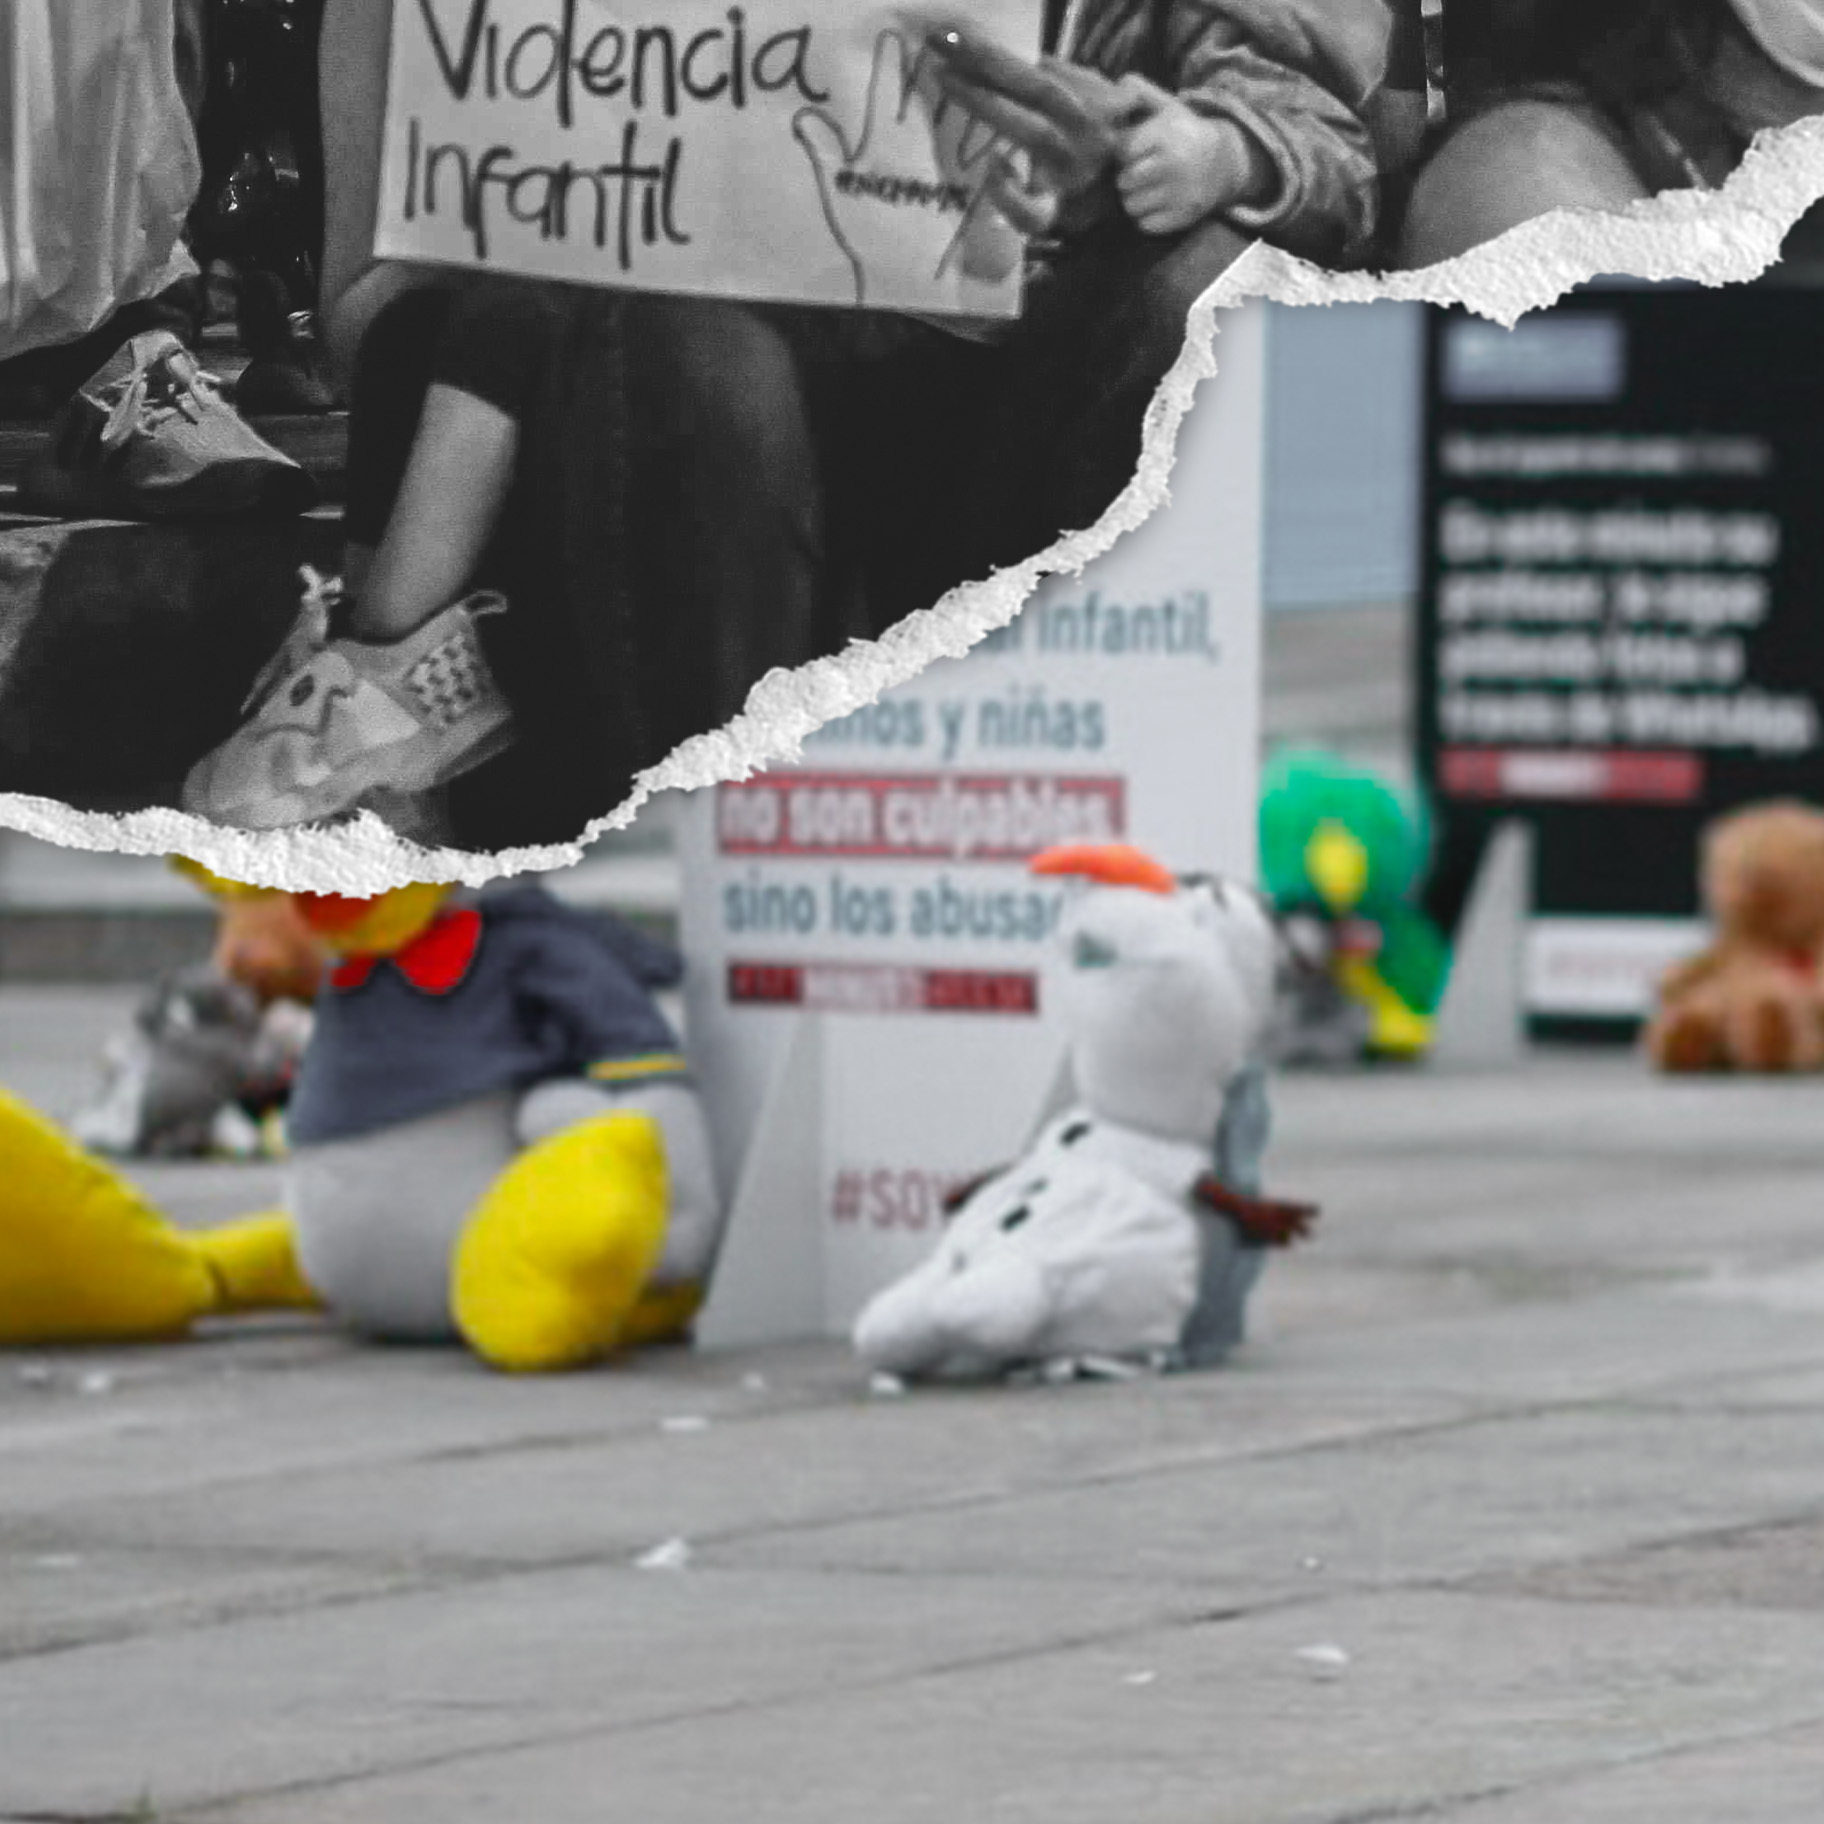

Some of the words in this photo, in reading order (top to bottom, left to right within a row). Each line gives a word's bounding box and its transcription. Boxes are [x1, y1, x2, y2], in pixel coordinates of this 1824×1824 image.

[404, 118, 690, 270] Infantil
[939, 700, 964, 763] y
[978, 686, 1105, 751] niñas
[724, 866, 817, 934] sino
[831, 872, 895, 936] los
